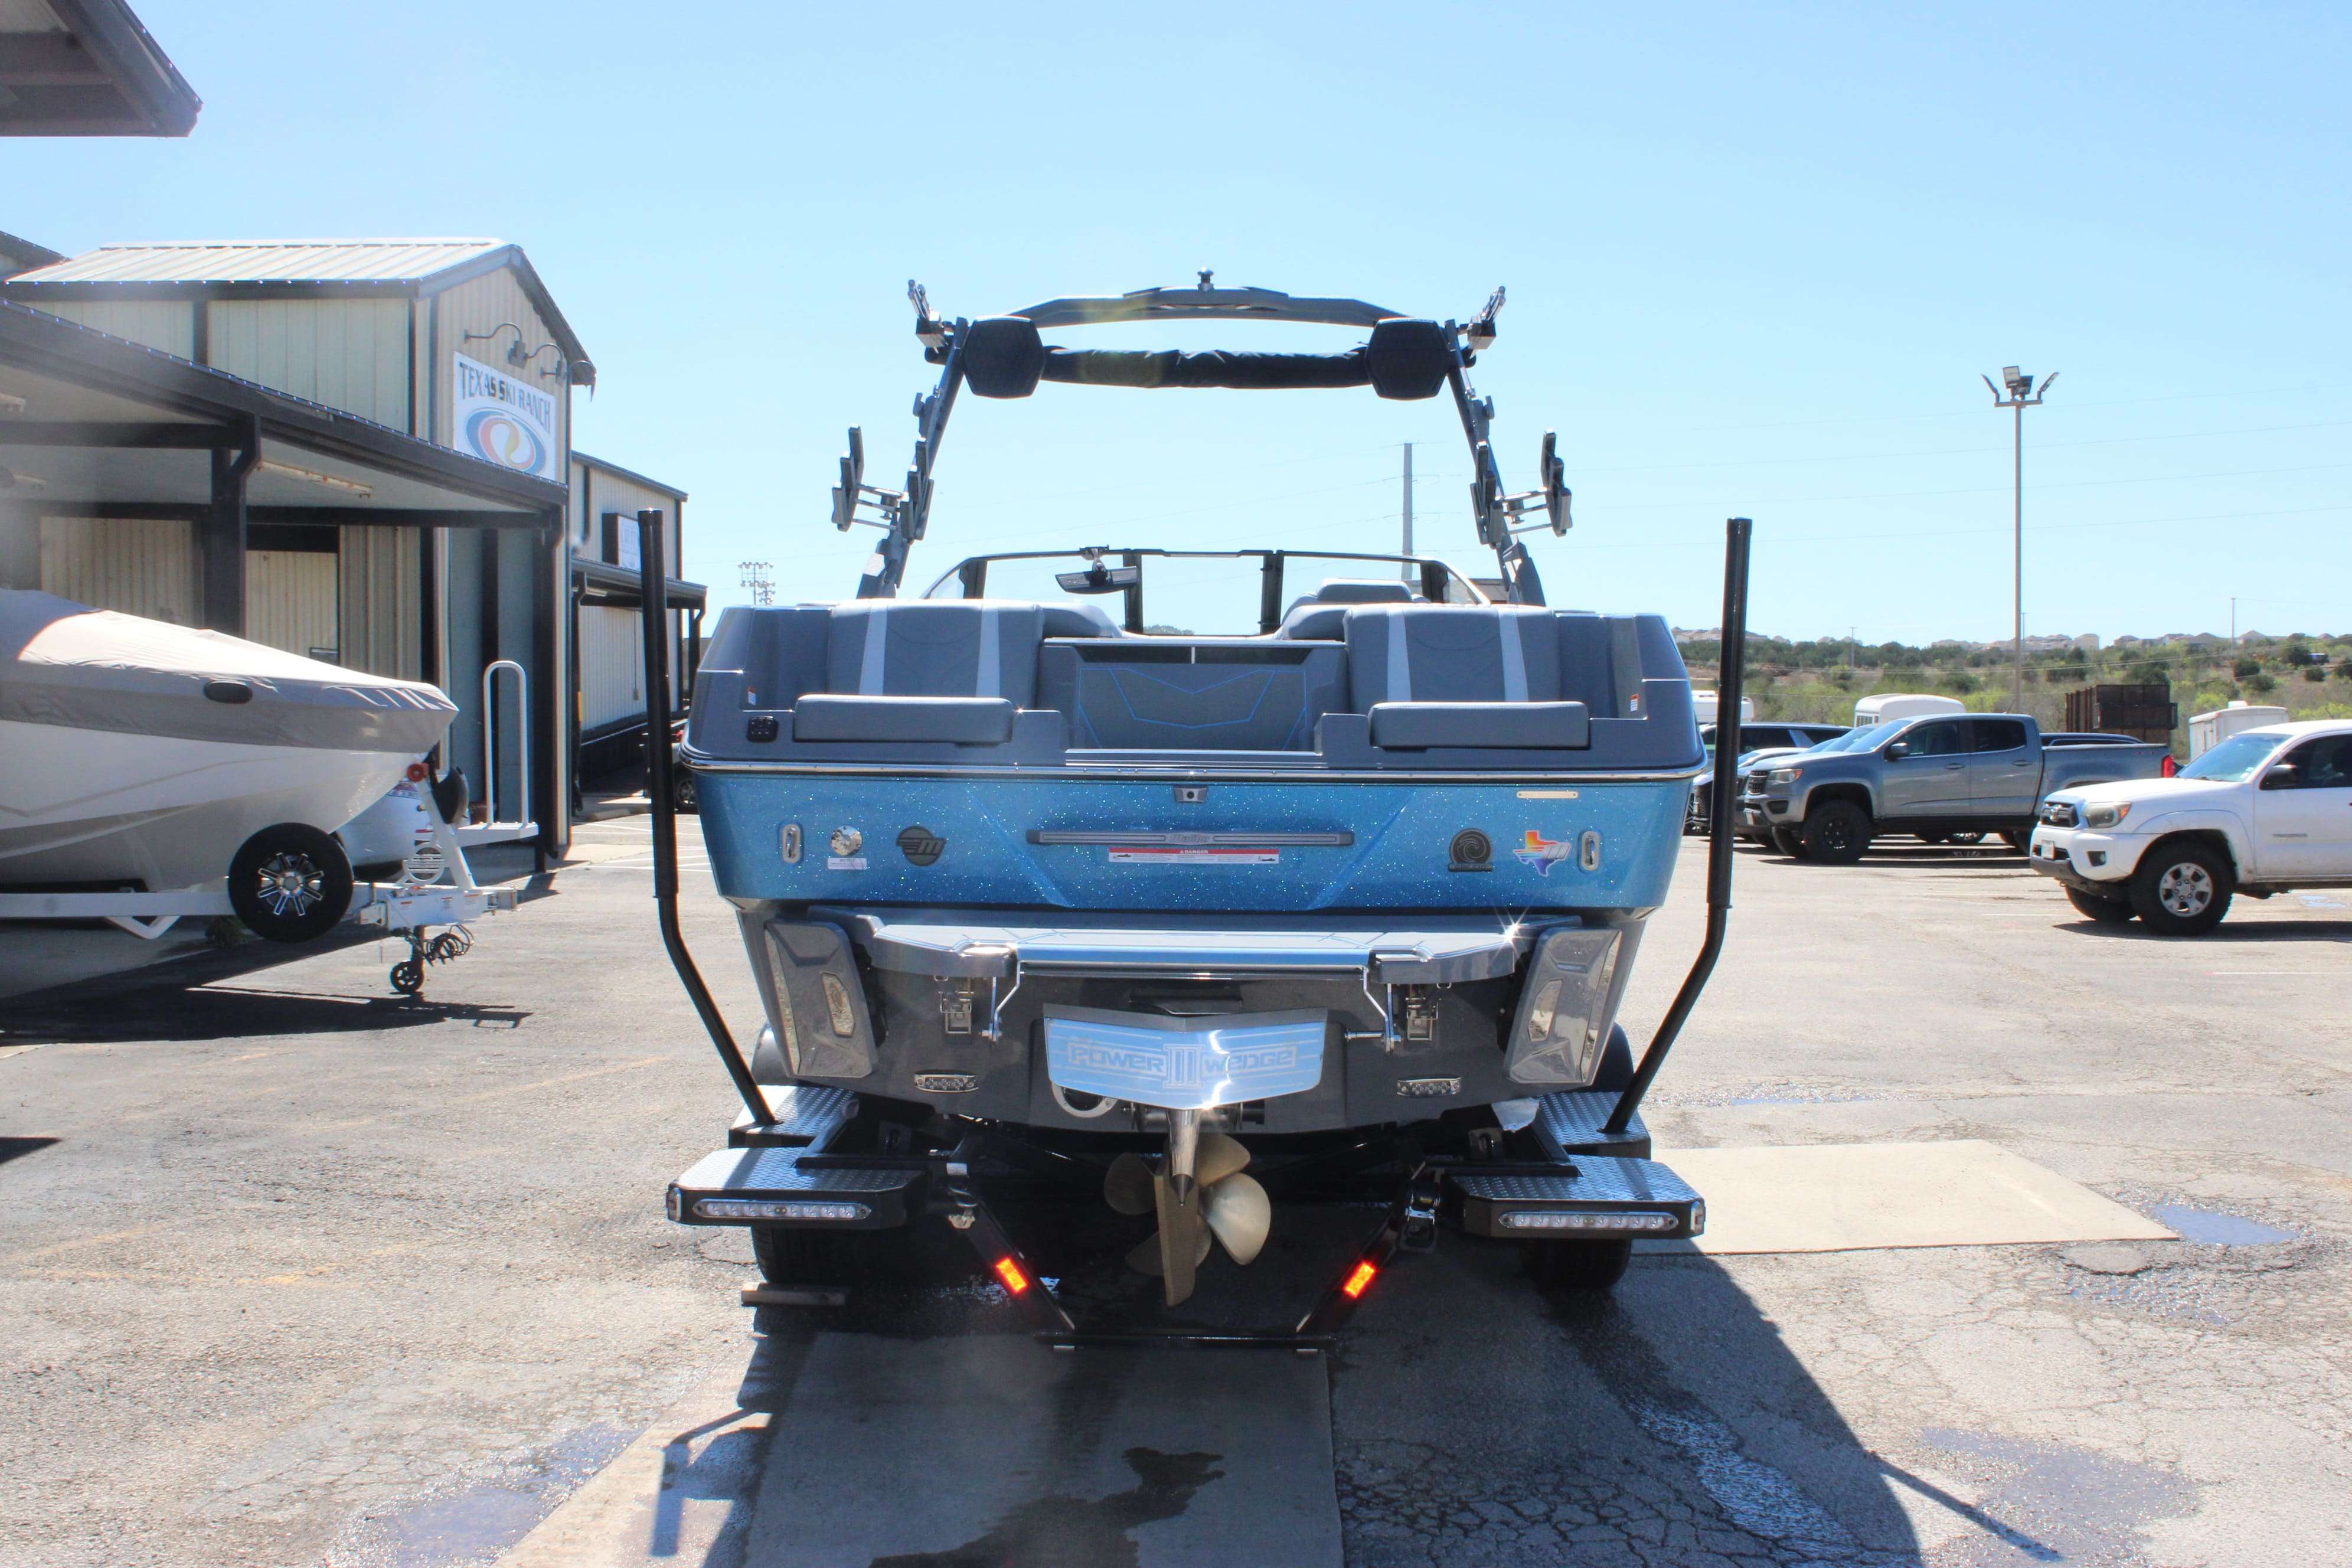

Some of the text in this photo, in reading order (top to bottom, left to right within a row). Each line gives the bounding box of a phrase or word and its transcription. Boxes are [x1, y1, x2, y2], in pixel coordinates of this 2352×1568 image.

[459, 362, 550, 435] TEXAS SKI RANCH
